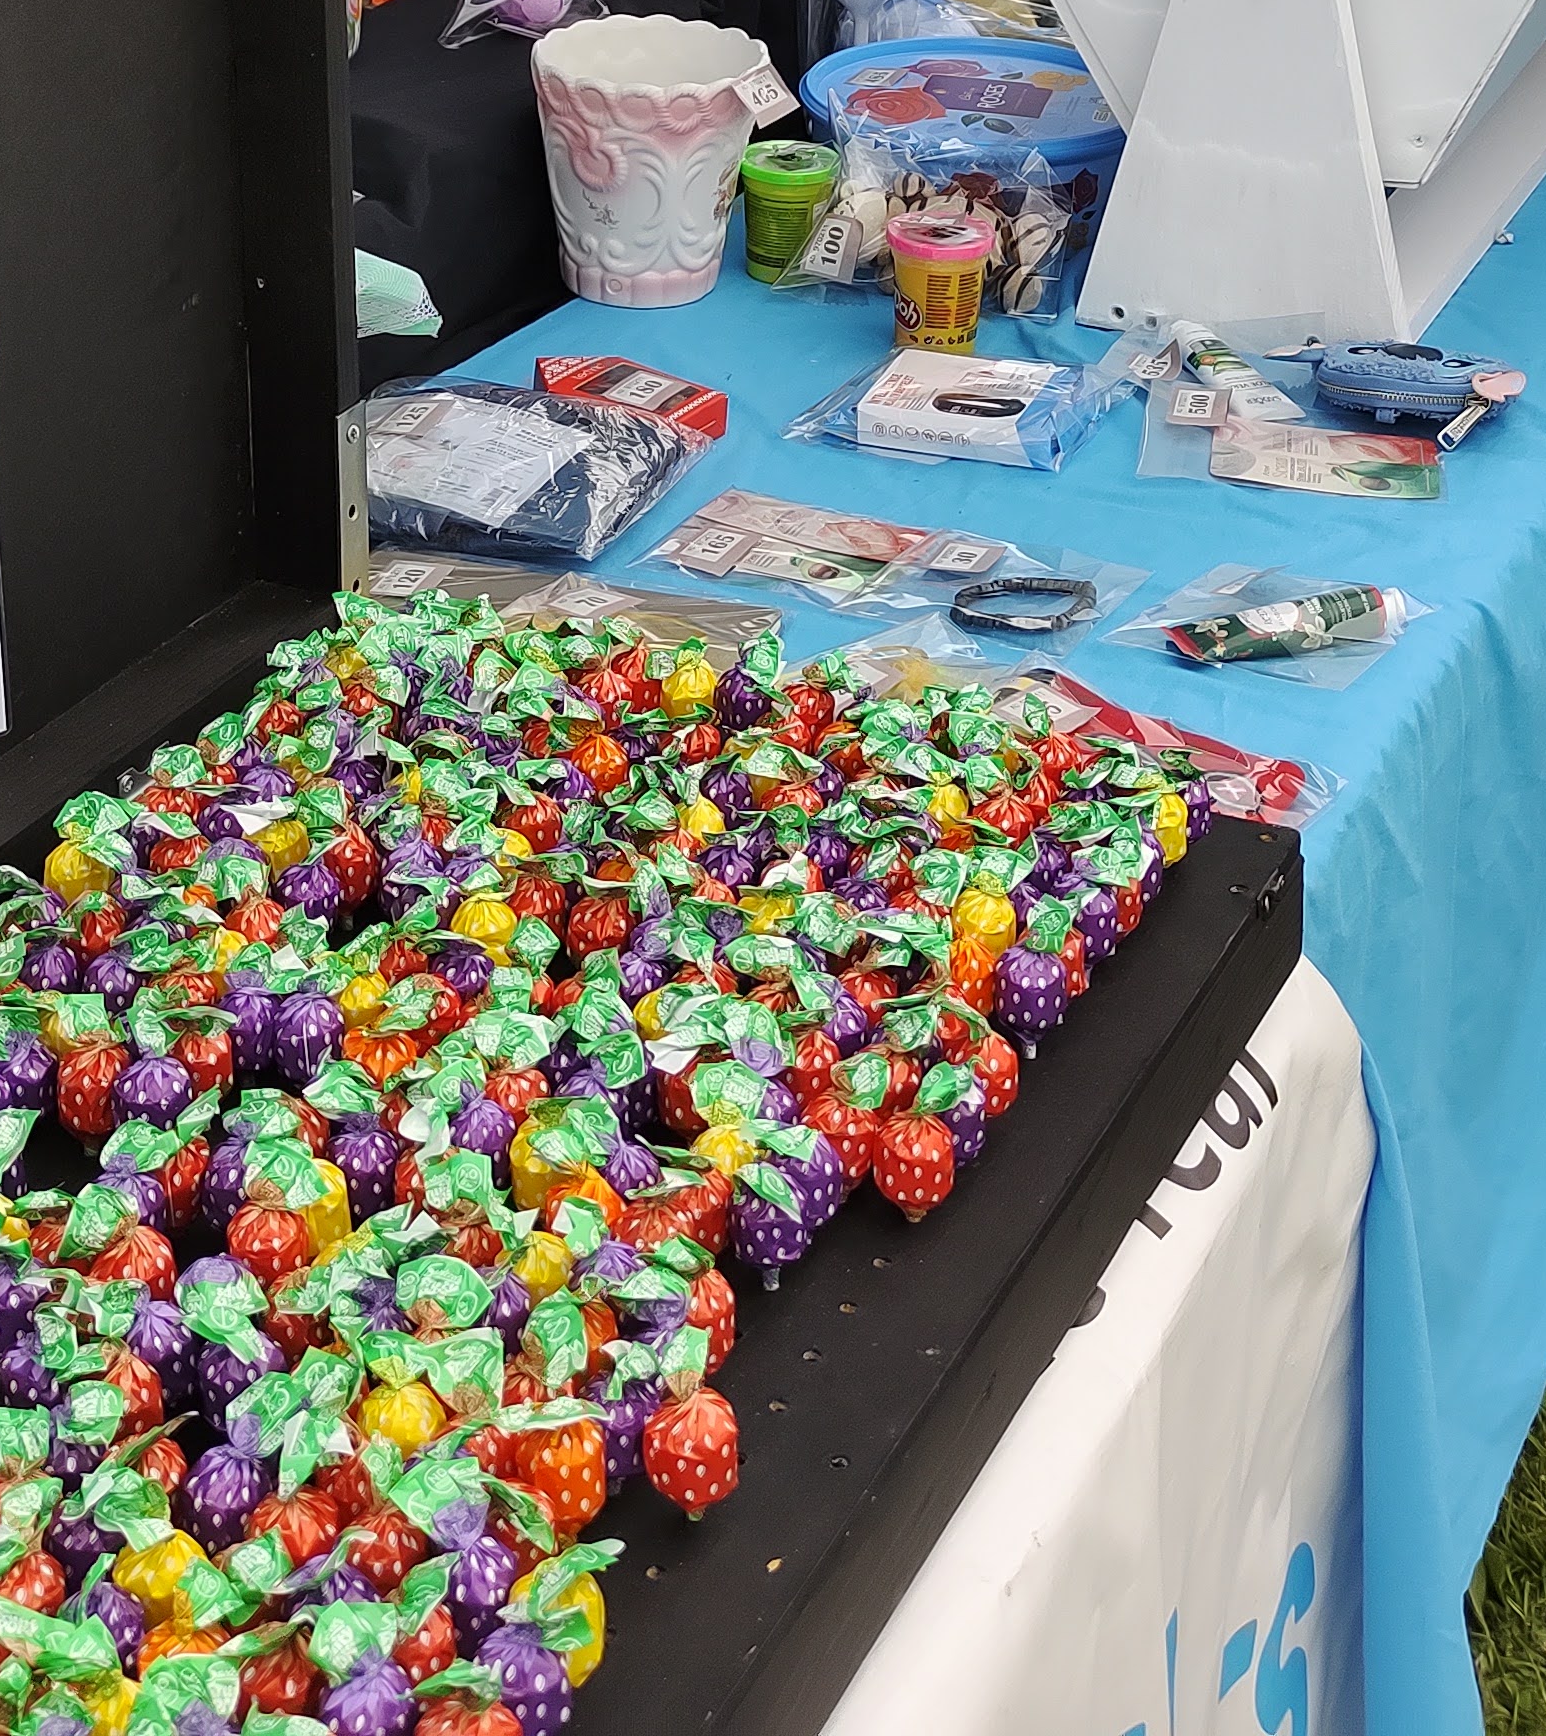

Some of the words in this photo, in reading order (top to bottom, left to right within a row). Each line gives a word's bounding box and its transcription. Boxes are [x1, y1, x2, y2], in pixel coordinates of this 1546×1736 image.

[976, 83, 1008, 110] ROSES
[821, 225, 845, 266] 100
[628, 379, 664, 400] 180
[1188, 394, 1210, 415] 500
[396, 405, 430, 428] 125
[701, 534, 735, 555] 165
[951, 551, 978, 565] 30
[392, 568, 426, 589] 120
[578, 595, 610, 608] 70
